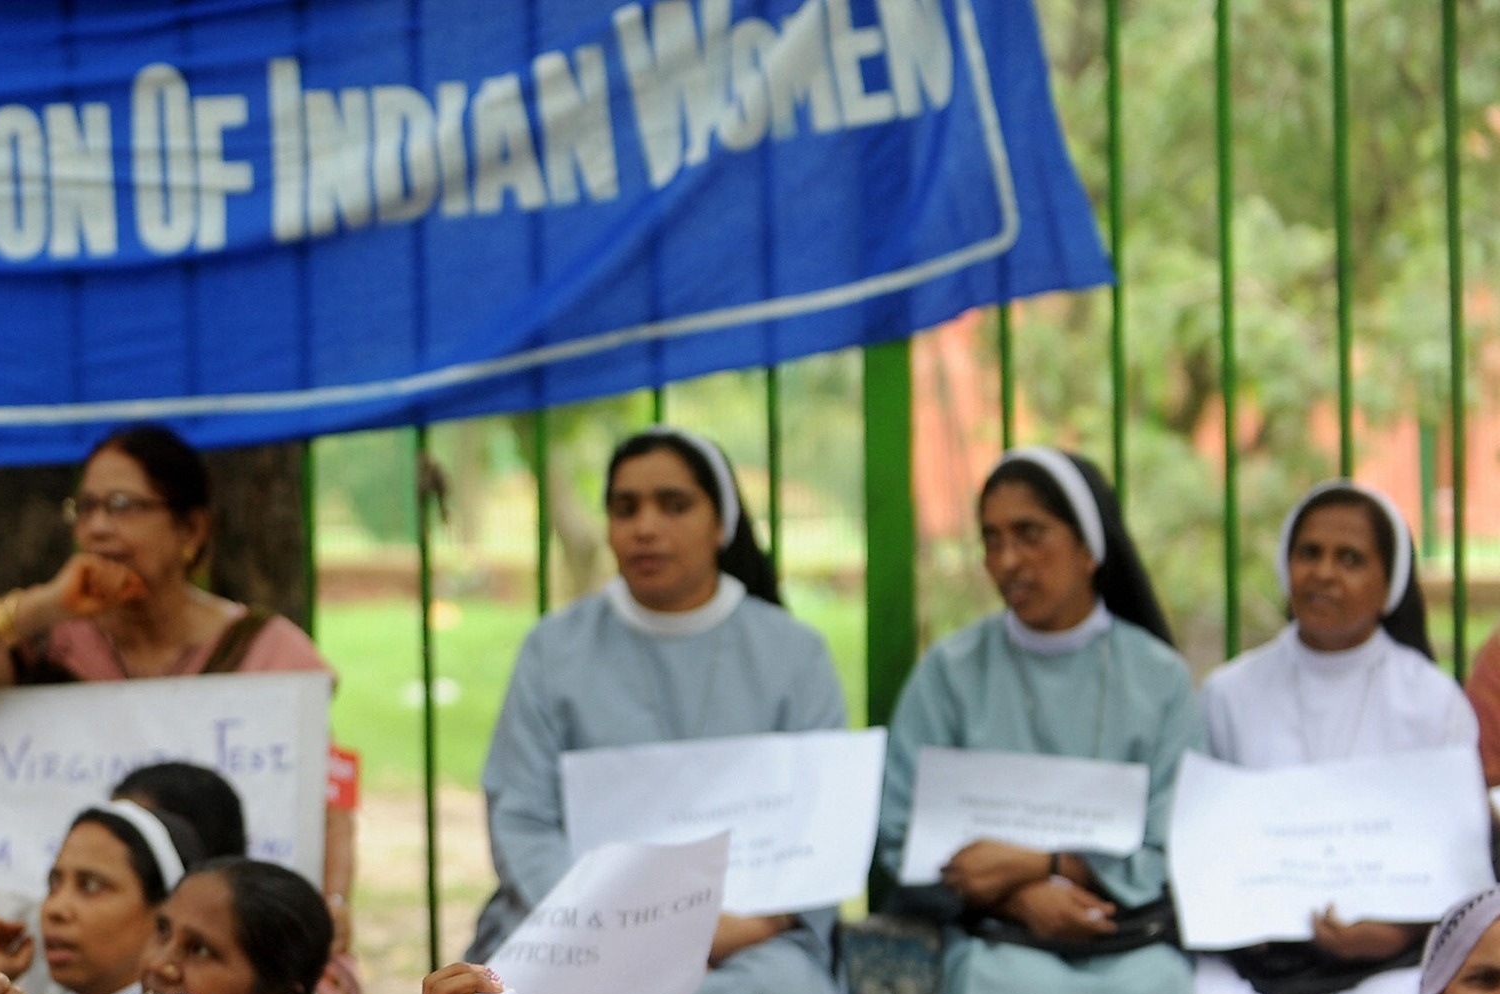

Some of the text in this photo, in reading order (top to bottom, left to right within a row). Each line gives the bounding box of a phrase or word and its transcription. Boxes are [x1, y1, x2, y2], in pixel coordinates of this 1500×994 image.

[131, 63, 254, 255] OF
[268, 50, 618, 241] INDIAN
[613, 0, 953, 190] WOMEN
